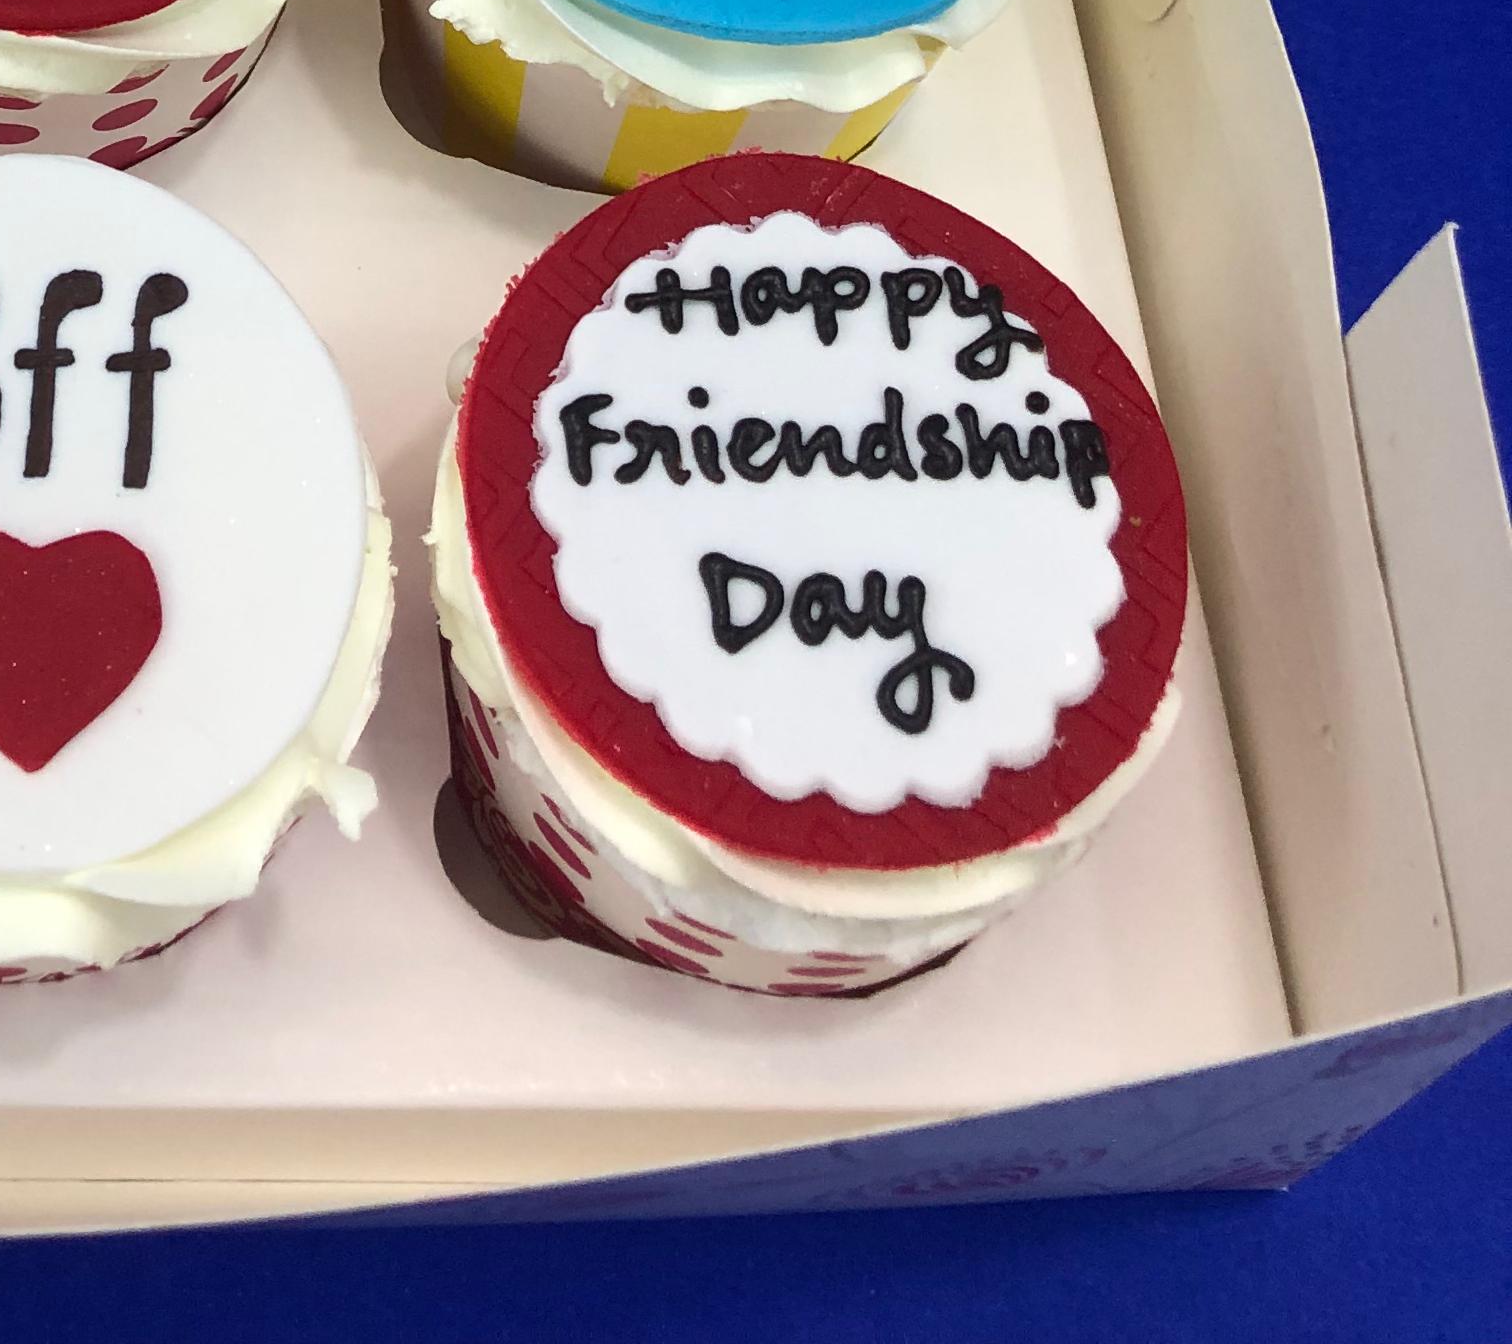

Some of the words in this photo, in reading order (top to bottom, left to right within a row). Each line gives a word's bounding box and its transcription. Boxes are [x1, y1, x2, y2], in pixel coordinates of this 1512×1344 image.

[624, 265, 1044, 381] Happy
[559, 386, 1111, 510] Friendship
[699, 551, 976, 735] Day
